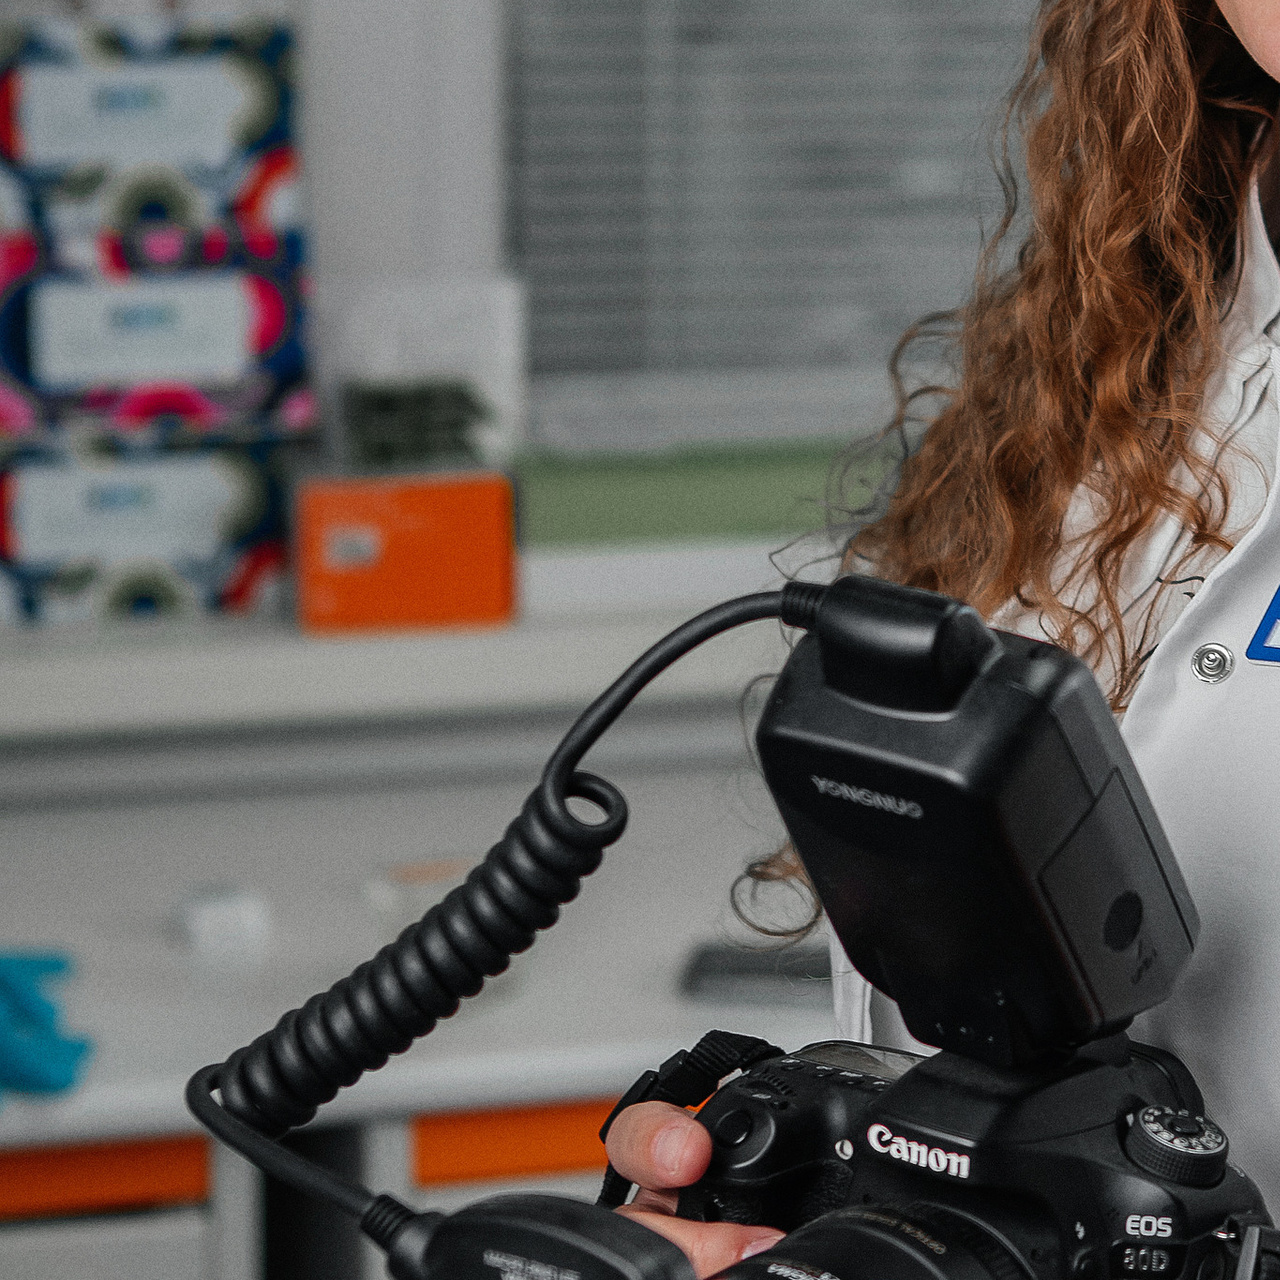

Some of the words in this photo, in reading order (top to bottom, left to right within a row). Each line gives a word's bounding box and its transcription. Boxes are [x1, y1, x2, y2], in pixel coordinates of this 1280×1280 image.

[810, 774, 923, 819] YONGNUO
[867, 1123, 970, 1178] Canon
[1126, 1214, 1172, 1237] EOS
